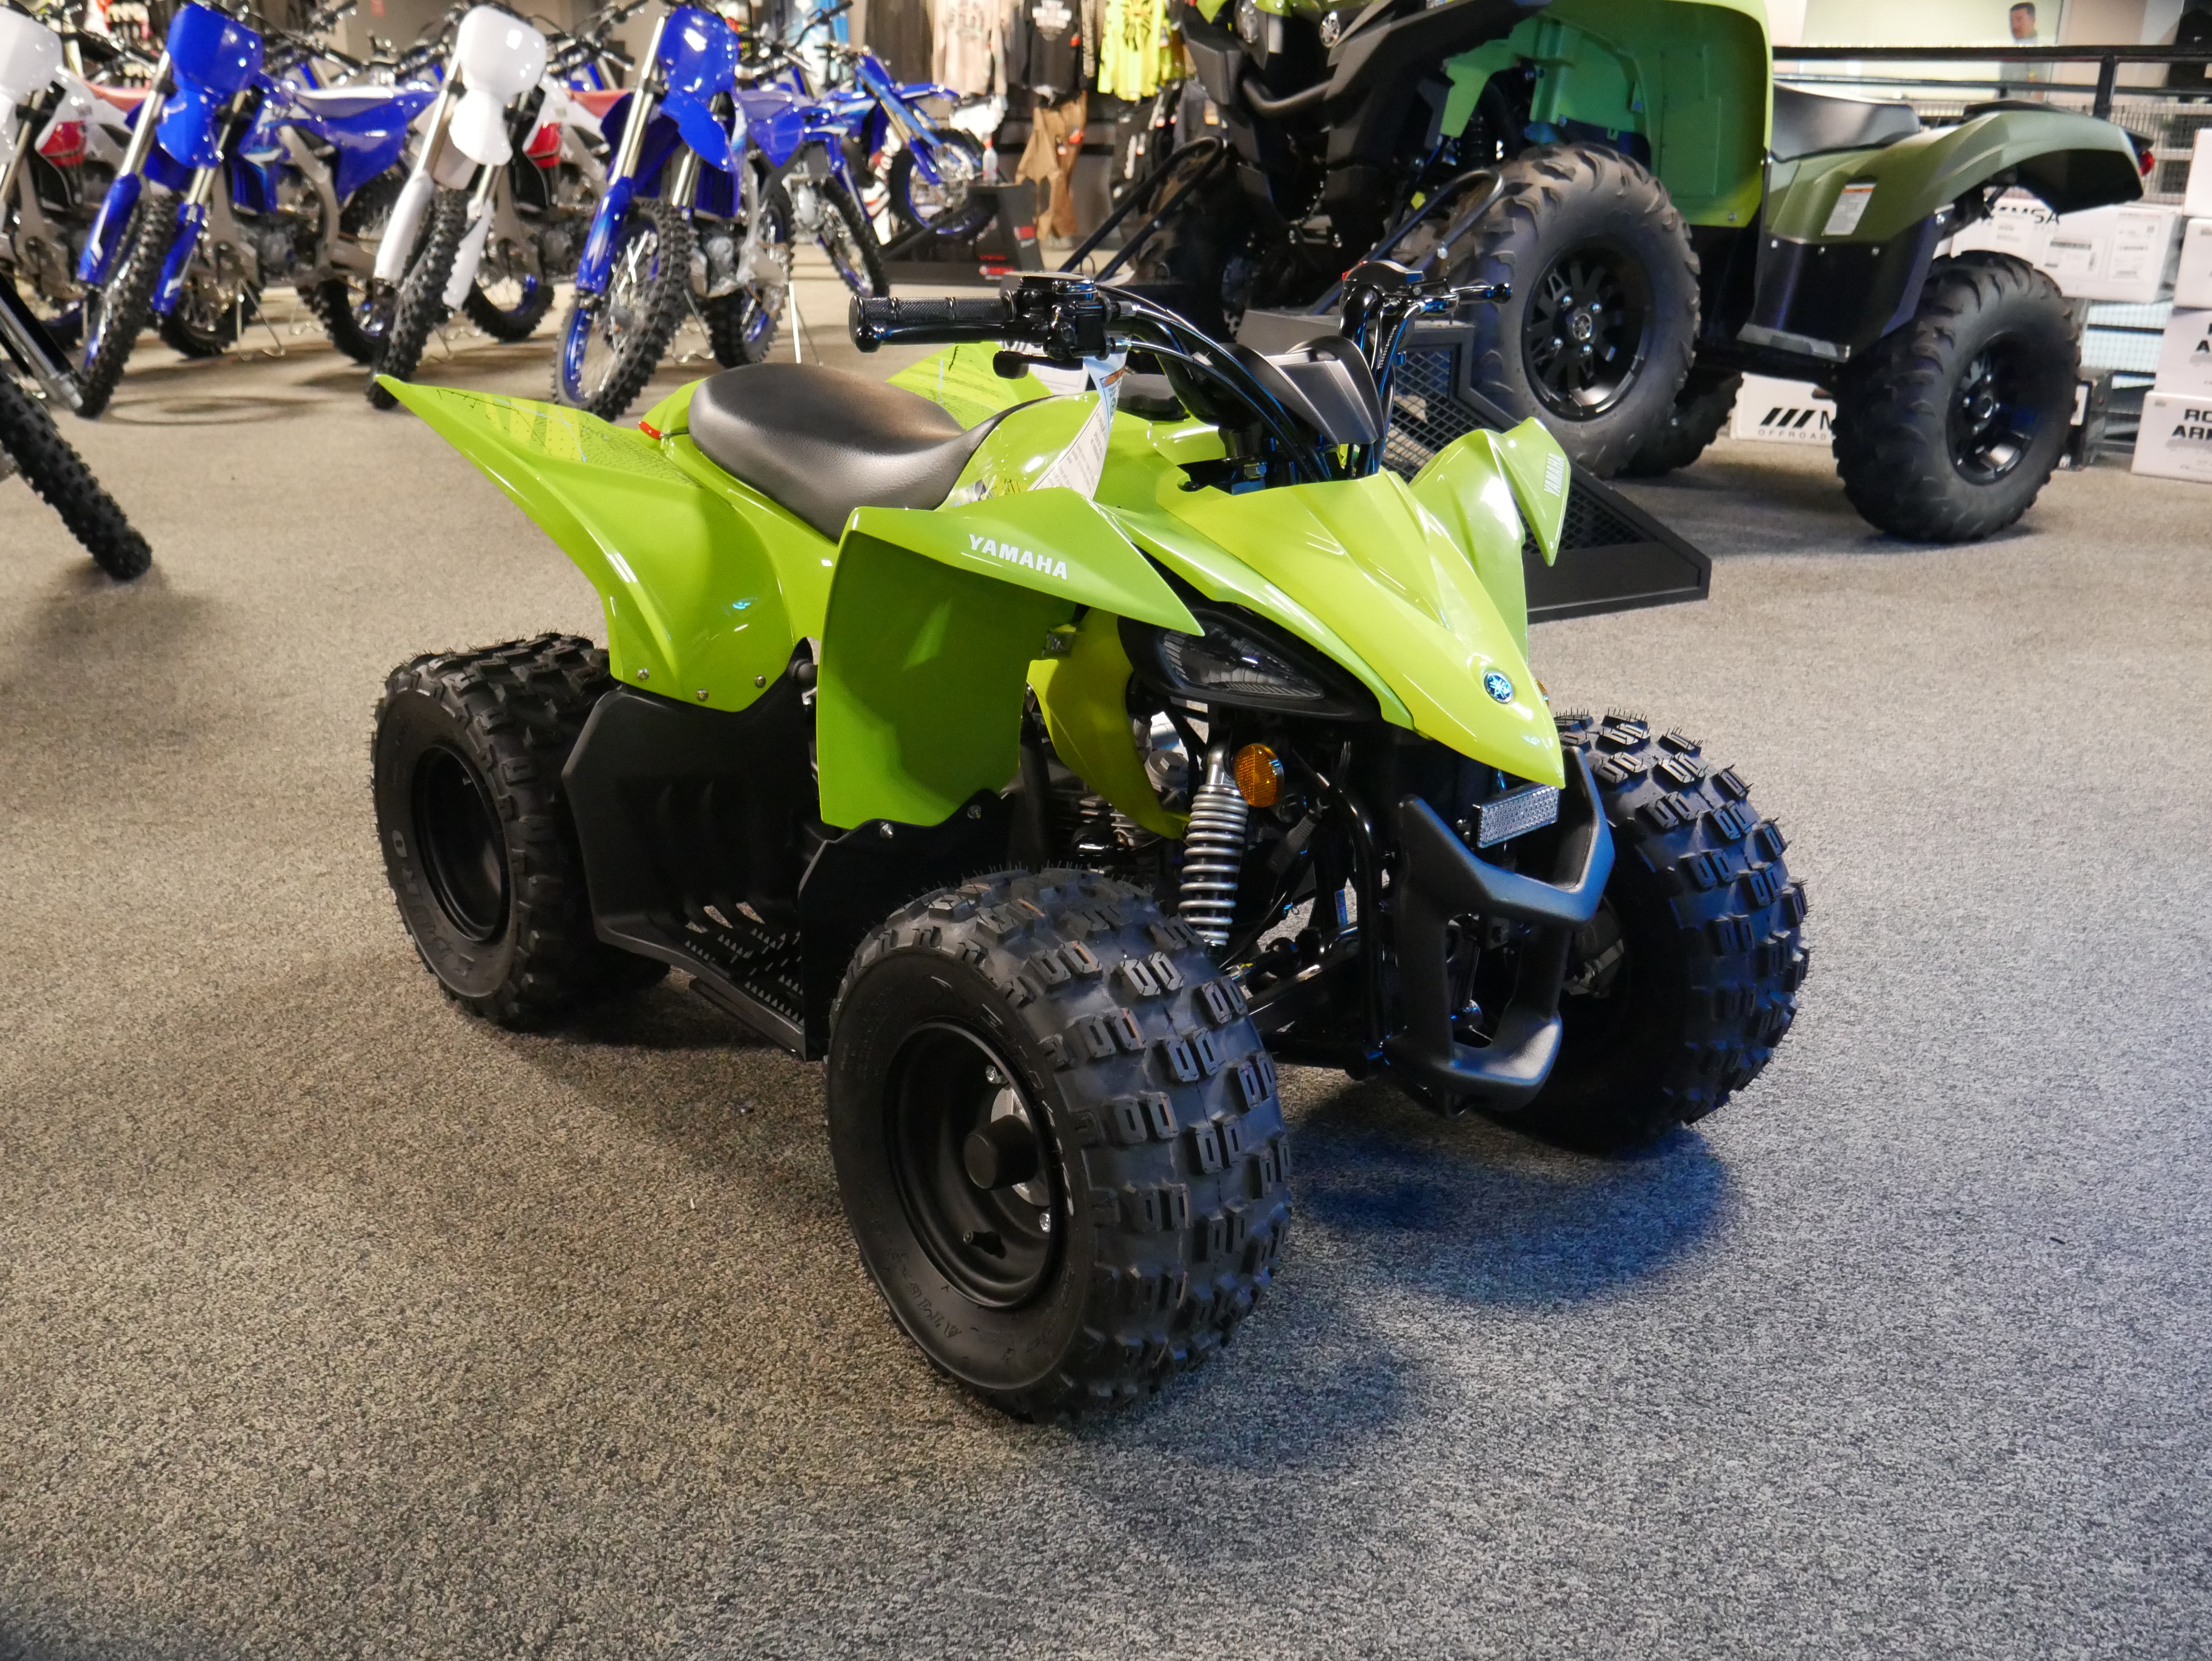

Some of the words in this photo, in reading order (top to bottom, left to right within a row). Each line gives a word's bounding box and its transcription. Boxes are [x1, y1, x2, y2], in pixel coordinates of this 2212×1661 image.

[1758, 429, 1827, 441] OFFROAD
[1543, 452, 1565, 497] YAMAHA
[969, 533, 1067, 580] YAMAHA
